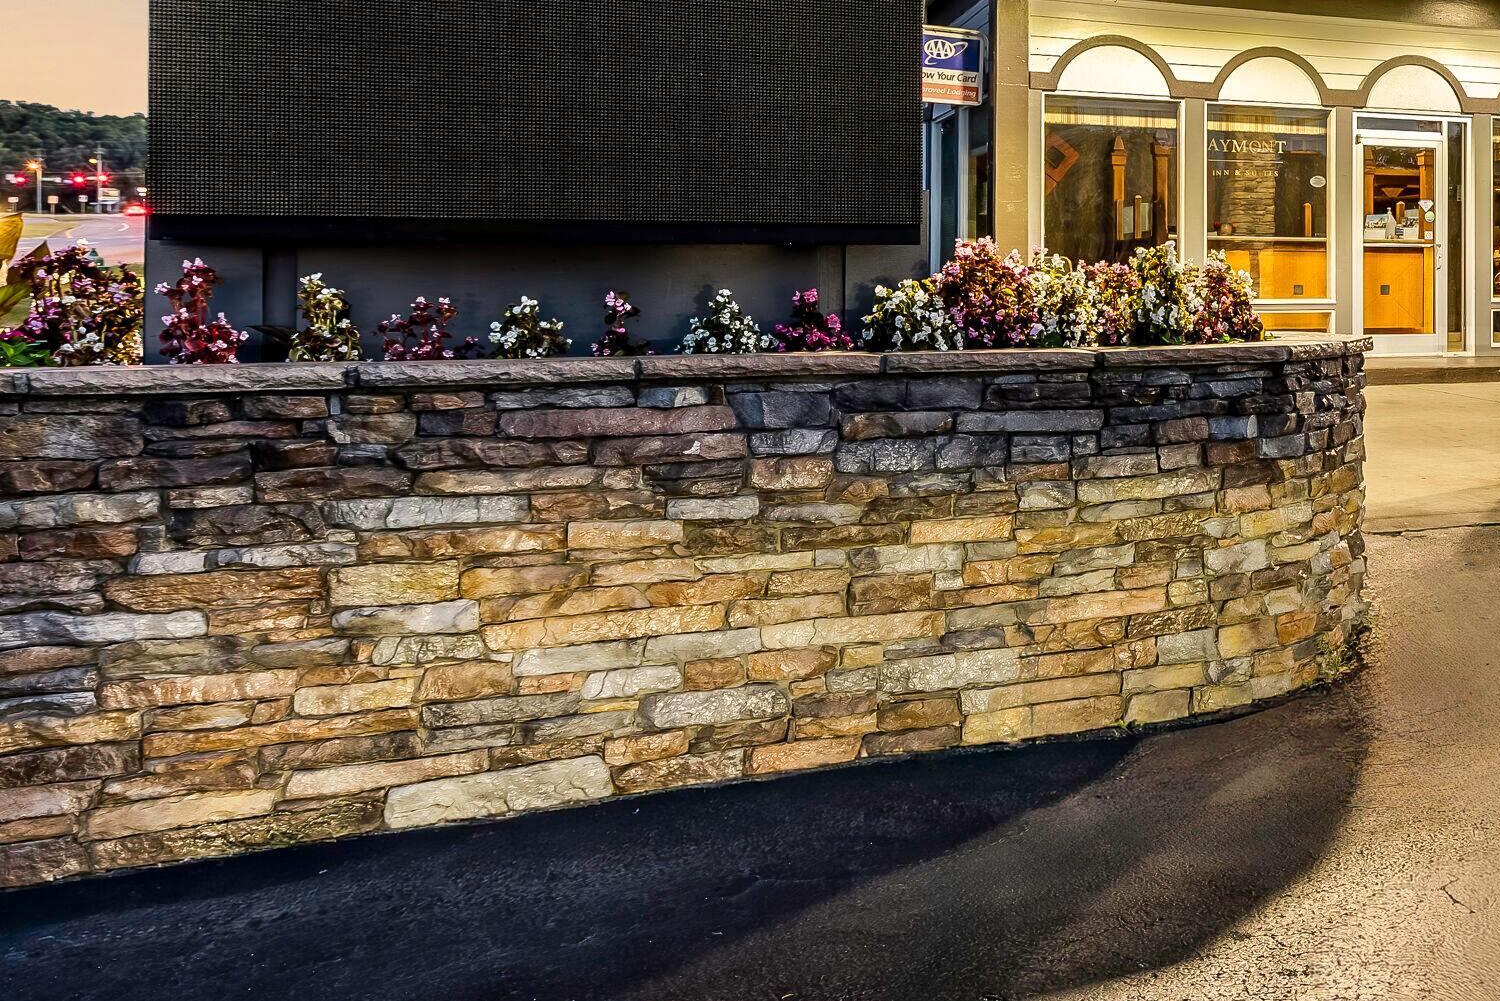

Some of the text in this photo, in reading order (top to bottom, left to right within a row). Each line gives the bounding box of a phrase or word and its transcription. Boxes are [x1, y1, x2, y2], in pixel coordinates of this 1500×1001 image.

[926, 39, 954, 59] AAA
[937, 71, 955, 81] Your
[957, 73, 978, 83] Card
[1212, 169, 1230, 177] INN
[1245, 170, 1279, 178] SUTES
